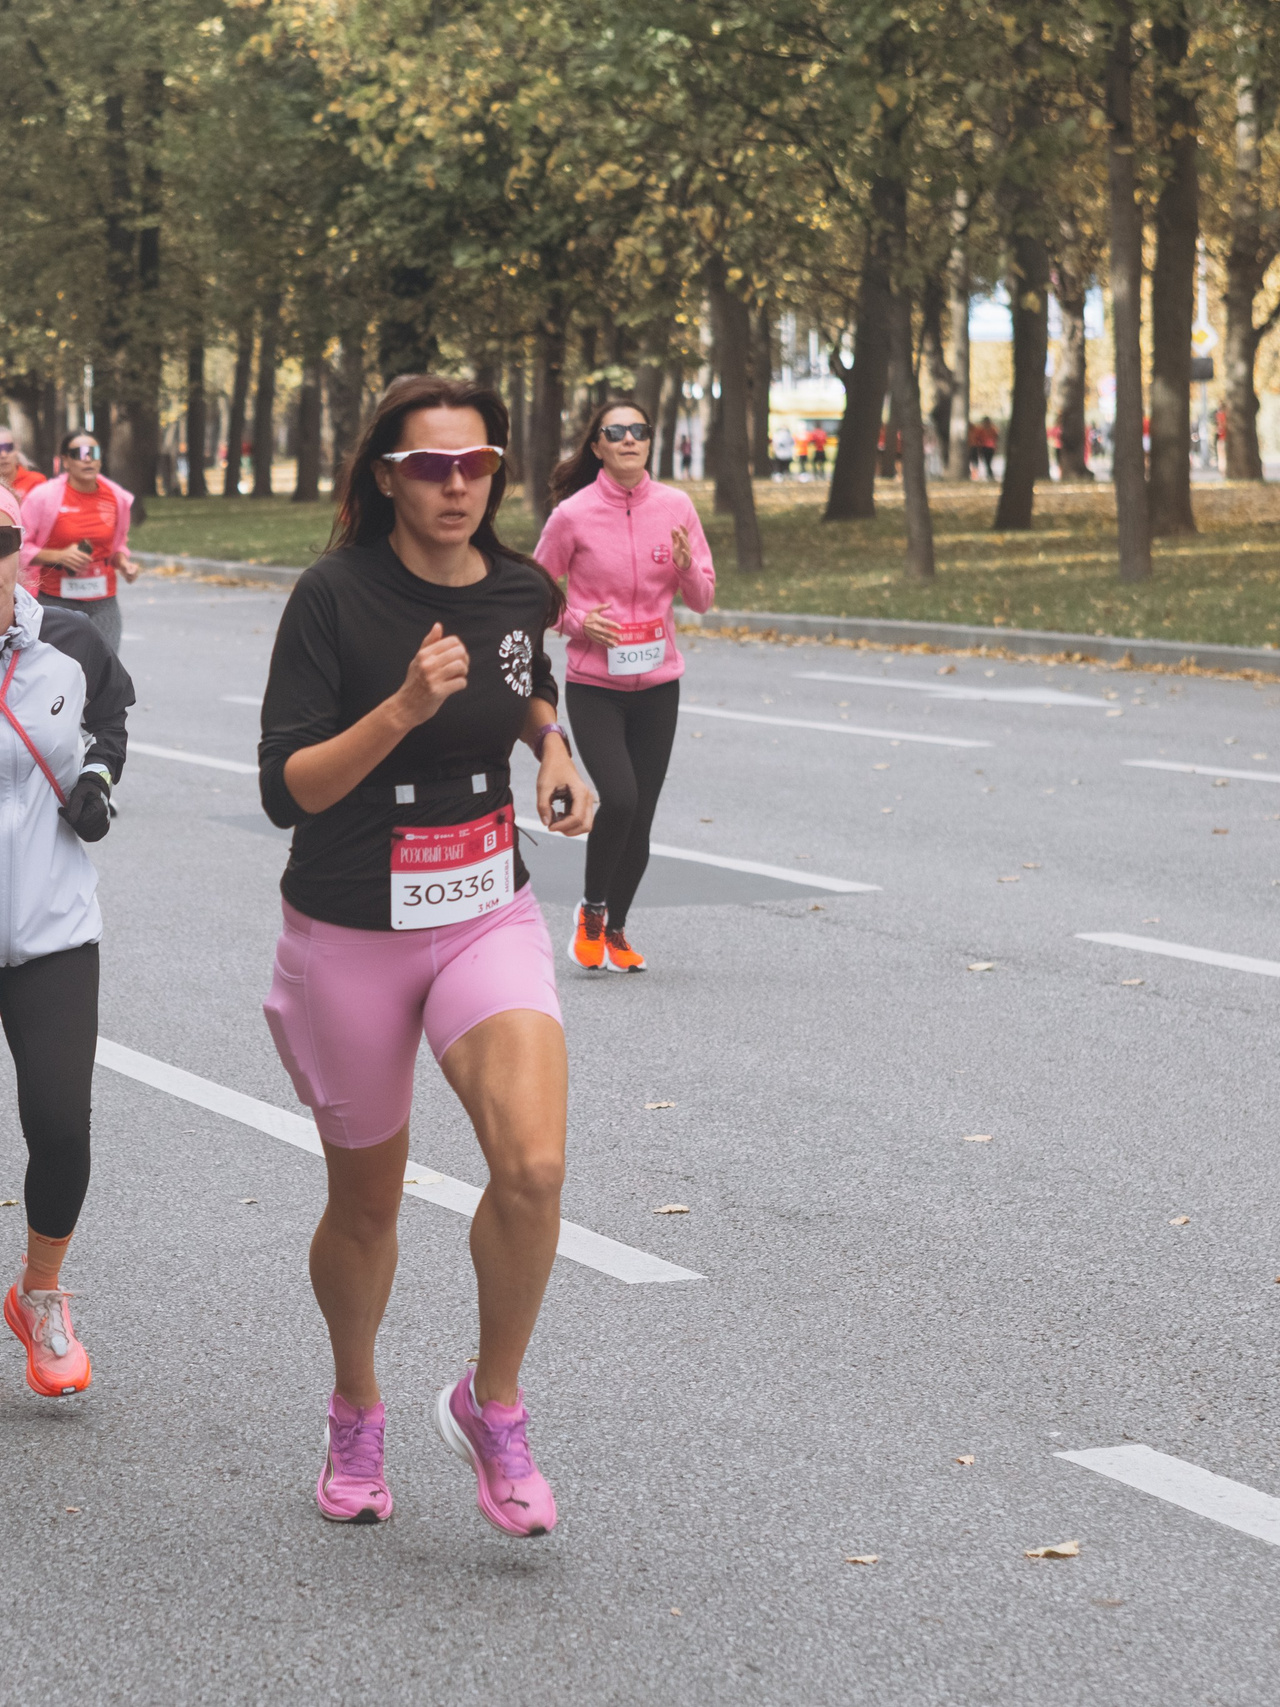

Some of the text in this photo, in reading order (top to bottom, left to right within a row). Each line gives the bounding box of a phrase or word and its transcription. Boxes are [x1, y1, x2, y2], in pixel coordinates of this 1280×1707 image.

[616, 647, 660, 664] 30152
[403, 869, 495, 907] 30336
[477, 904, 483, 913] 3
